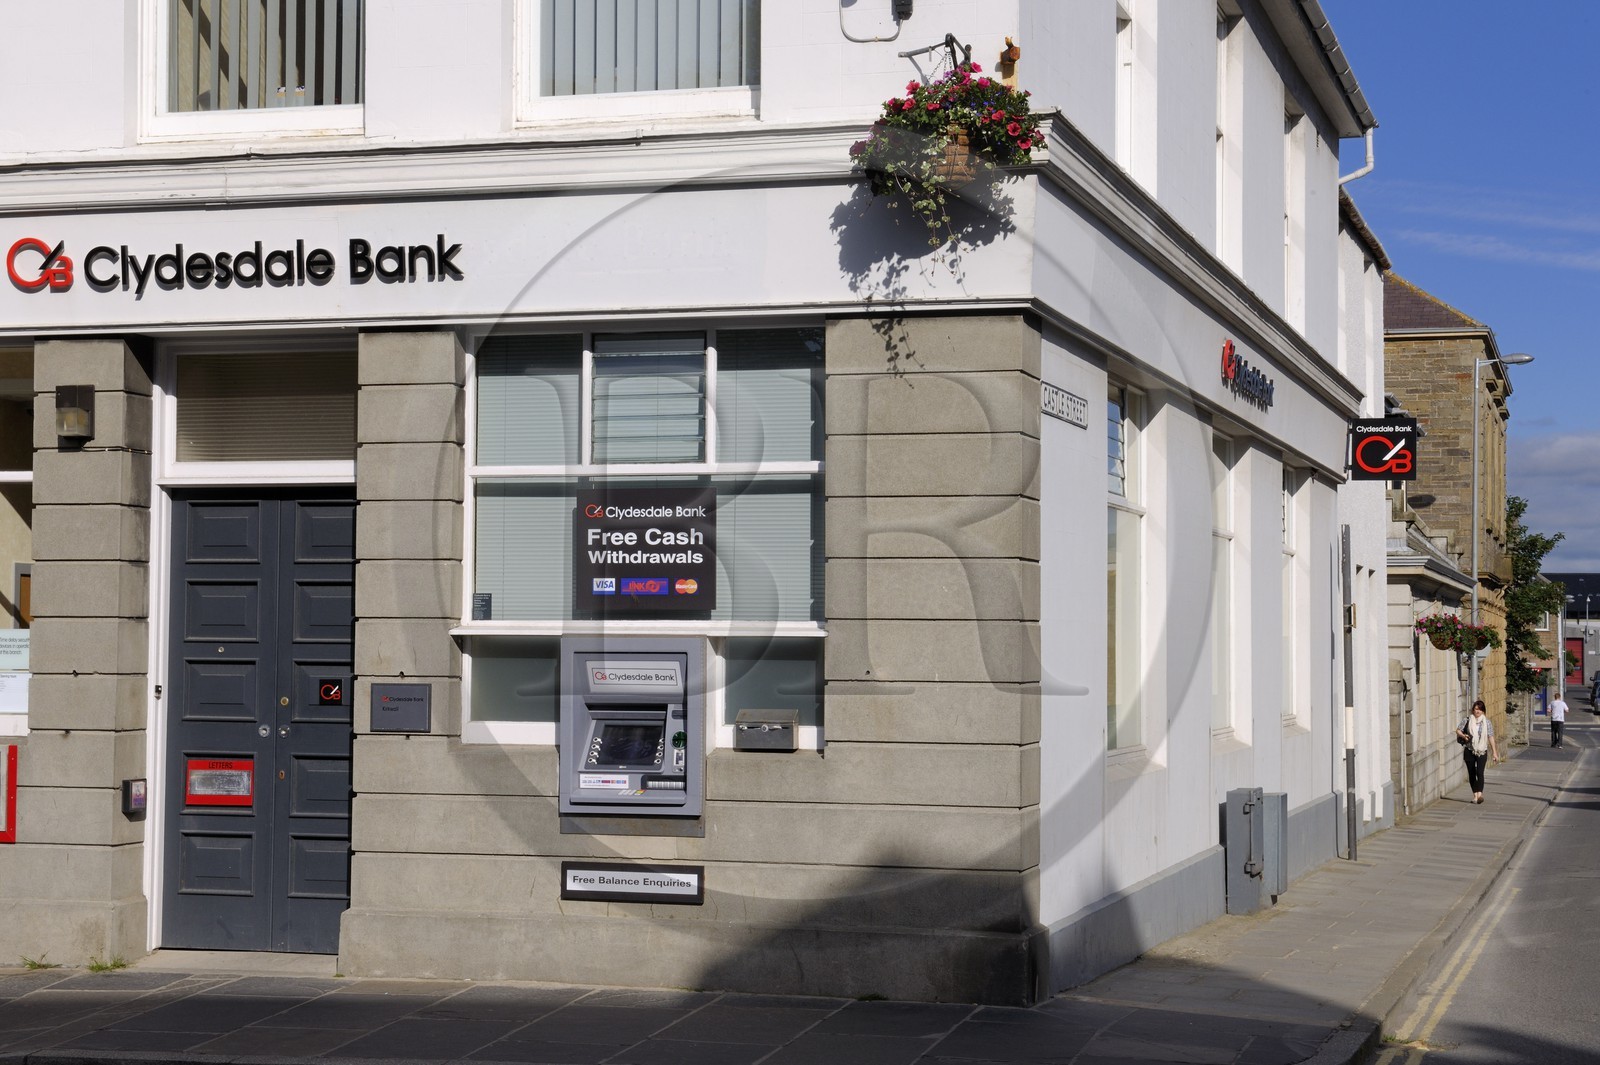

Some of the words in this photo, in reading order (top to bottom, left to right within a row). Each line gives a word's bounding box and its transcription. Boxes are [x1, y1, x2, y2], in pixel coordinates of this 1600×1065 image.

[84, 238, 336, 297] Clydesdale
[349, 233, 465, 283] Bank
[1043, 385, 1065, 415] CASTLE
[1066, 395, 1086, 424] STREET
[1356, 425, 1394, 434] Clydesdale
[605, 506, 673, 520] Clydesdale
[675, 506, 707, 517] Bank
[587, 528, 638, 546] Free
[644, 527, 704, 546] Cash
[587, 550, 704, 564] Withdrawals
[595, 580, 614, 589] VISA
[608, 673, 653, 682] Clydesdale
[655, 673, 675, 682] Bank
[208, 761, 233, 769] LETTERS
[572, 875, 595, 884] Free
[598, 876, 640, 886] Balance
[643, 877, 692, 888] Enquiries
